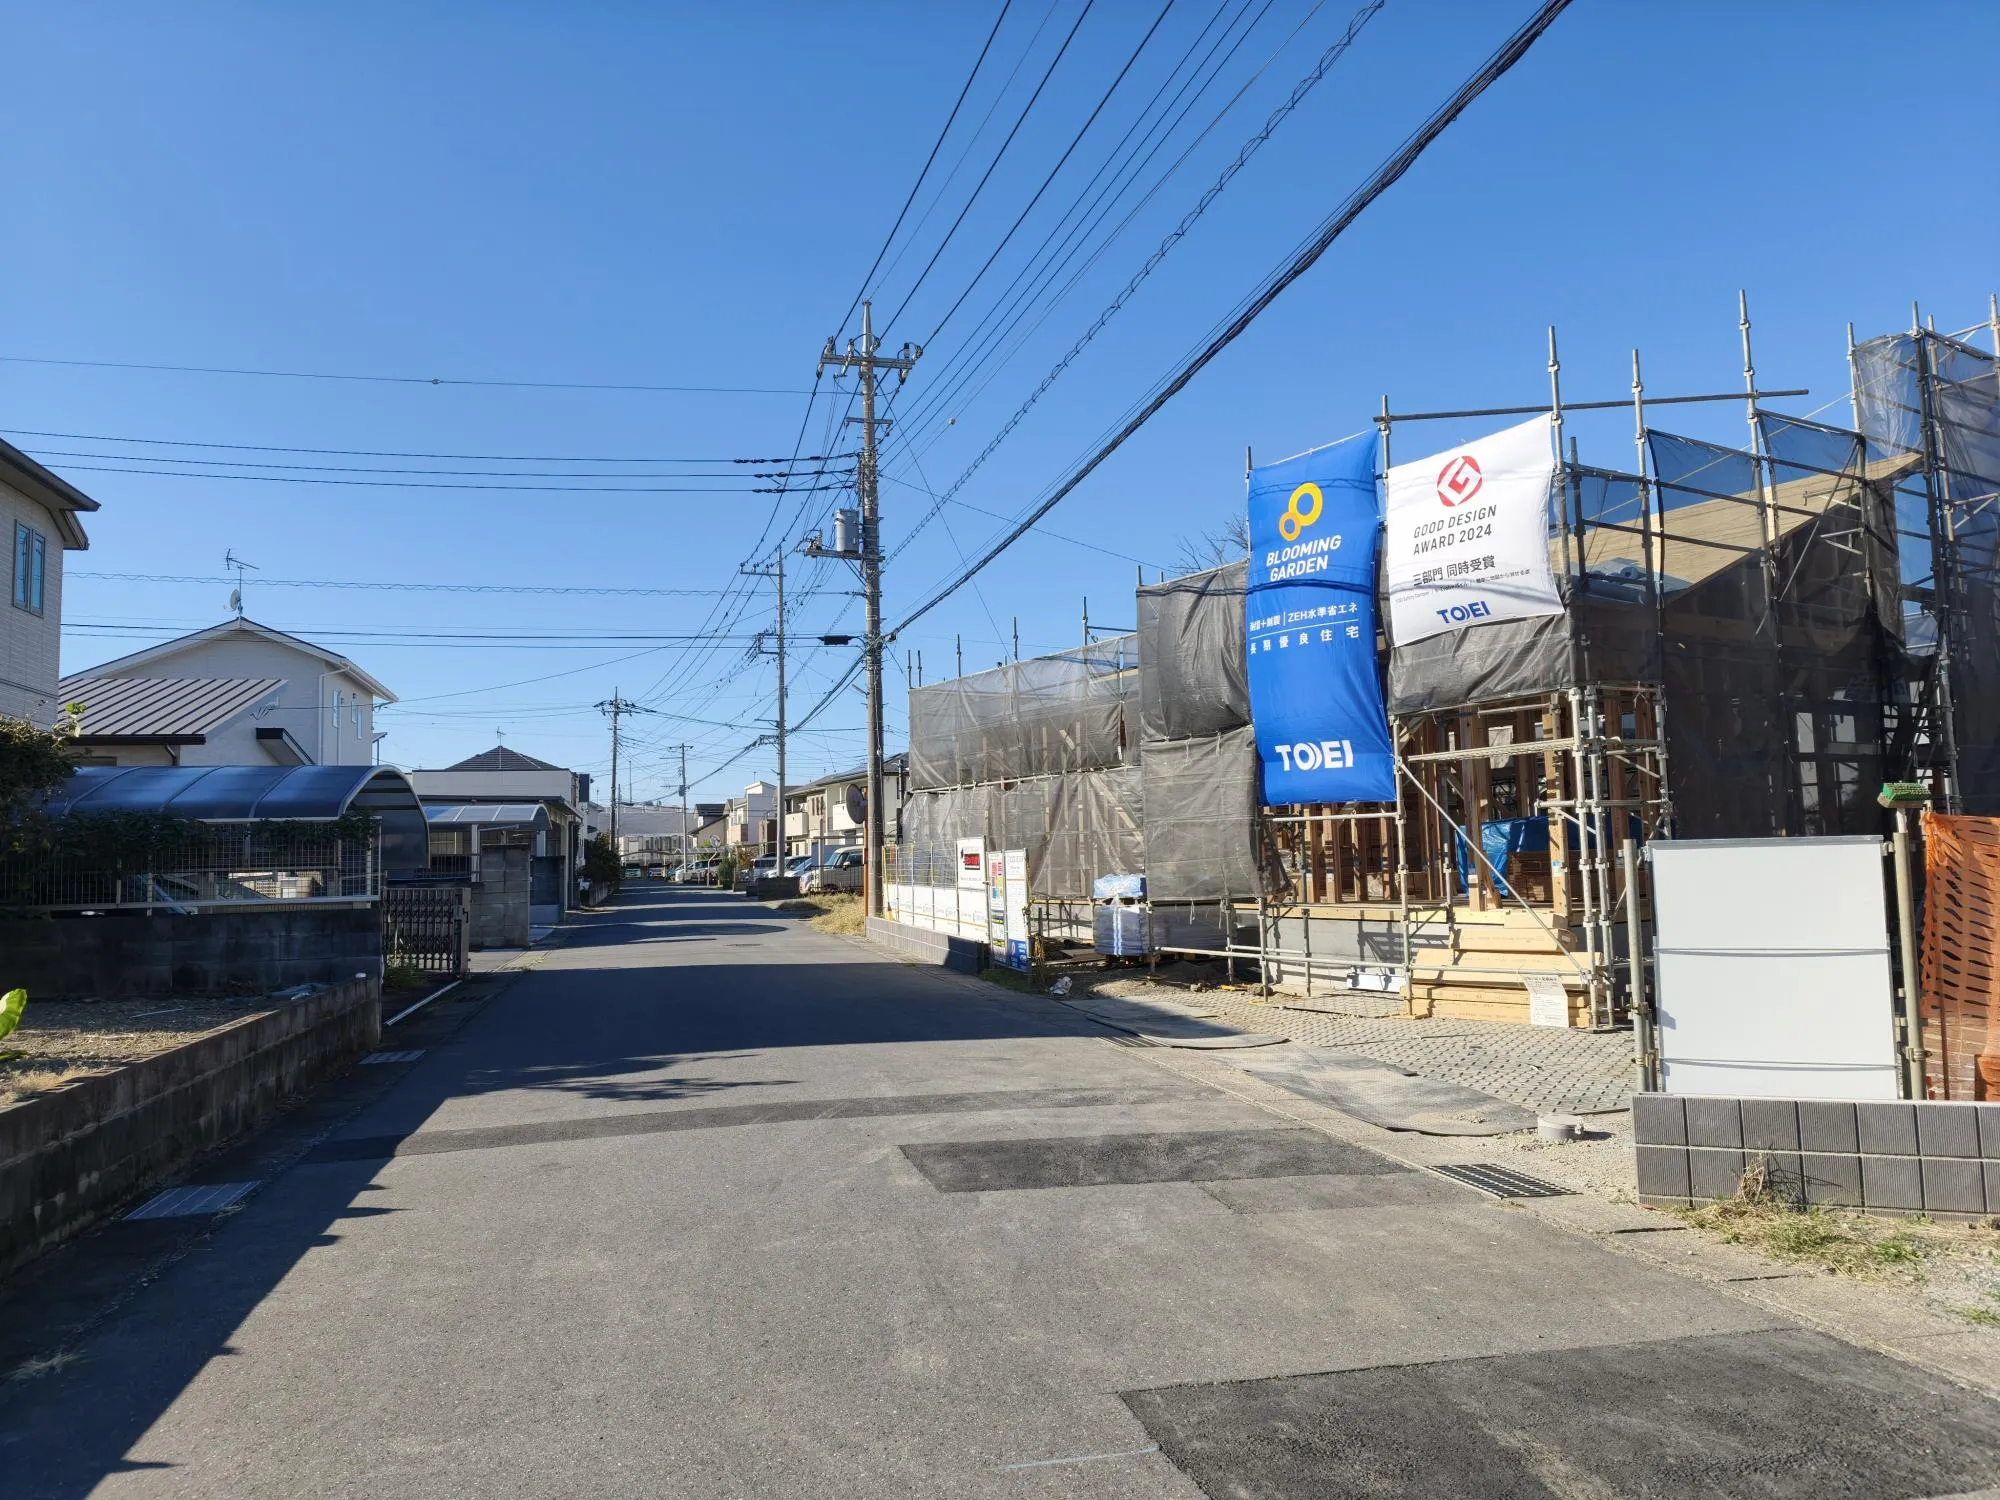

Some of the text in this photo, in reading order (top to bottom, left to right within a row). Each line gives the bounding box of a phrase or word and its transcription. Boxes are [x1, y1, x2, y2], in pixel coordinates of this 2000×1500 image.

[1413, 504, 1497, 539] GOOD DESIGN
[1266, 535, 1342, 567] BLOOMING
[1413, 523, 1493, 556] AWARD 2024
[1270, 555, 1329, 582] GARDEN
[1412, 567, 1444, 587] 三部門
[1446, 555, 1496, 579] 同時受賞
[1287, 602, 1359, 623] ZEH水準省エネ
[1436, 600, 1492, 624] TOEI
[1274, 739, 1354, 772] TOEI
